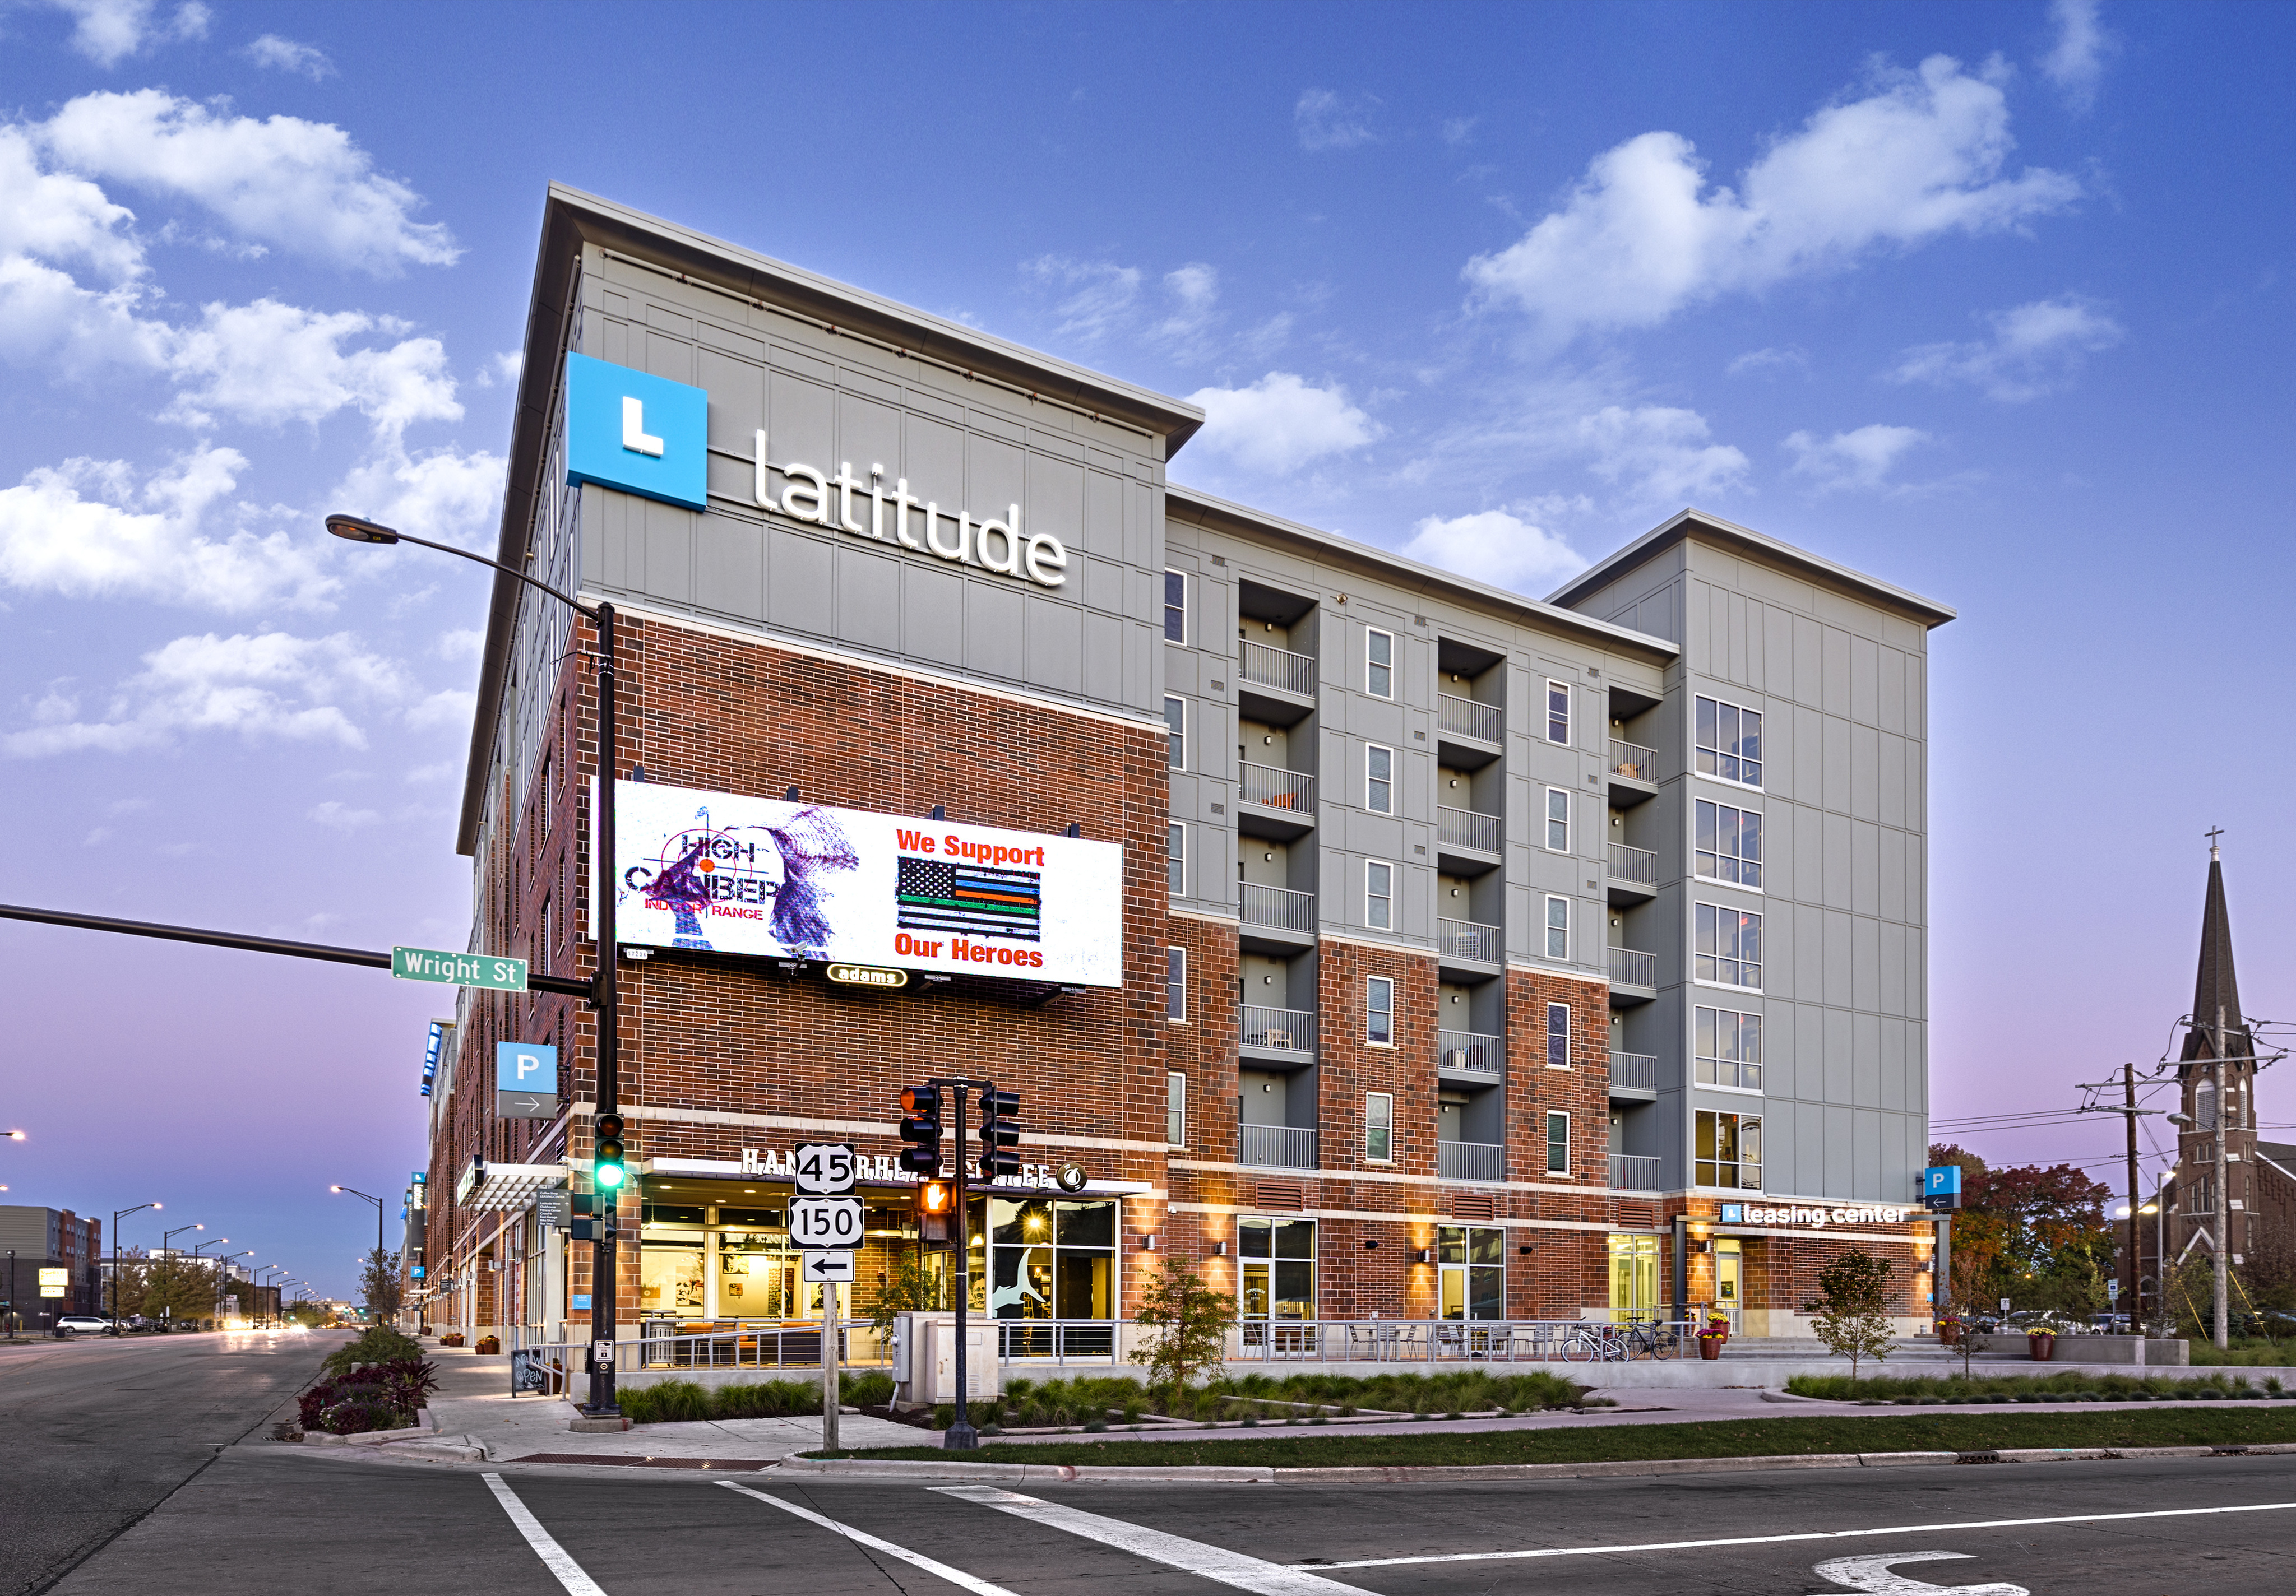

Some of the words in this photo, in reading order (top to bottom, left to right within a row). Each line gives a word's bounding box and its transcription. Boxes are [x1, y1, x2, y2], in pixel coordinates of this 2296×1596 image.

[622, 396, 664, 458] L
[755, 429, 1067, 587] latitude
[682, 834, 754, 862] HIGH
[896, 829, 935, 853] We
[945, 835, 1045, 866] Support
[644, 898, 702, 915] INDR
[712, 905, 763, 920] RANGE
[895, 933, 943, 958] Our
[952, 938, 1043, 968] Heroes
[404, 952, 480, 982] Wright
[493, 961, 516, 983] St
[838, 968, 897, 984] adams
[517, 1054, 540, 1080] P
[741, 1148, 944, 1183] HARHE
[799, 1154, 850, 1182] 45
[1933, 1173, 1945, 1188] P
[800, 1208, 853, 1236] 150
[1744, 1204, 1826, 1228] leasing
[1831, 1205, 1911, 1223] center
